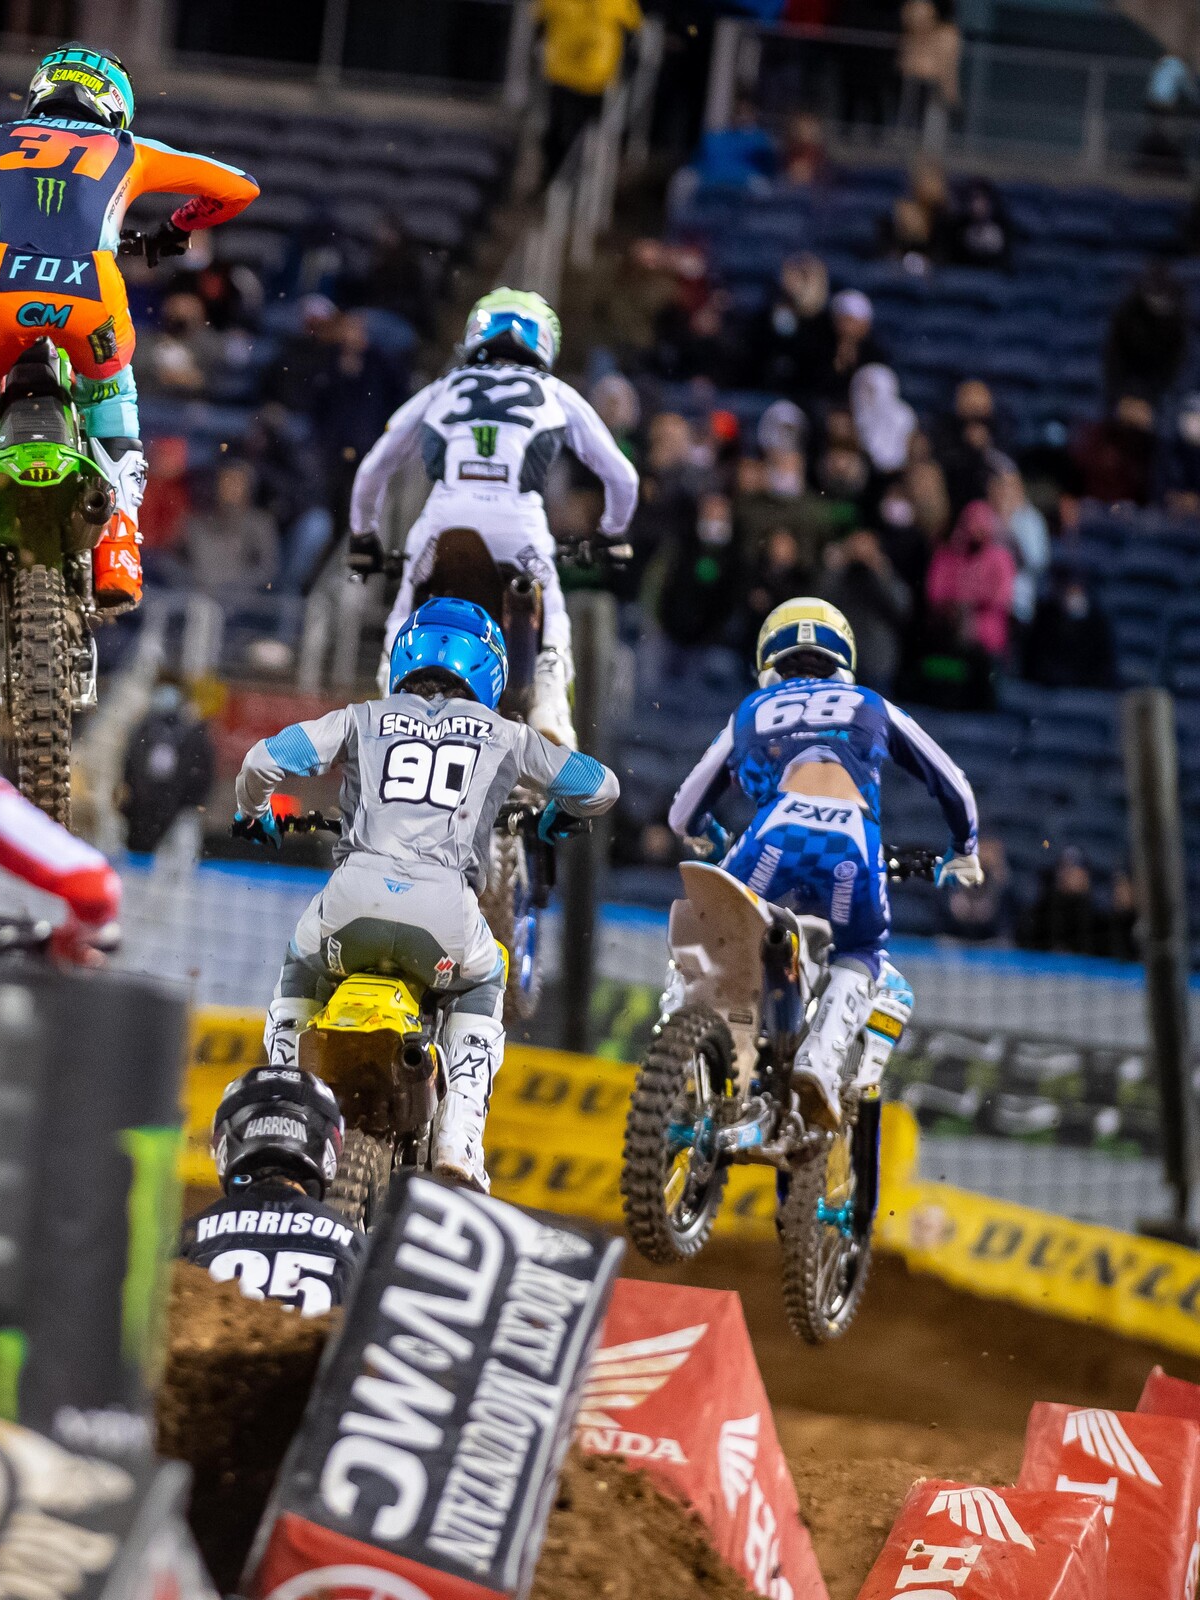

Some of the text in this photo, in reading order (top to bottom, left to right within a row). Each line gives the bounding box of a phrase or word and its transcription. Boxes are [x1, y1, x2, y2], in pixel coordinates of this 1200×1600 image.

[51, 69, 104, 93] CAMERON
[111, 88, 124, 108] BELL
[9, 256, 90, 285] FOX
[442, 375, 545, 429] 32
[380, 712, 492, 740] SCHWARTZ
[755, 689, 865, 736] 68
[379, 738, 482, 811] 90
[783, 800, 853, 824] FXR
[747, 844, 784, 894] YAMAHA
[243, 1116, 308, 1143] HARRISON
[196, 1210, 354, 1247] HARRISON
[490, 1256, 593, 1377] ROCKY
[578, 1428, 690, 1465] NDA
[426, 1357, 563, 1576] MOUNTAIN
